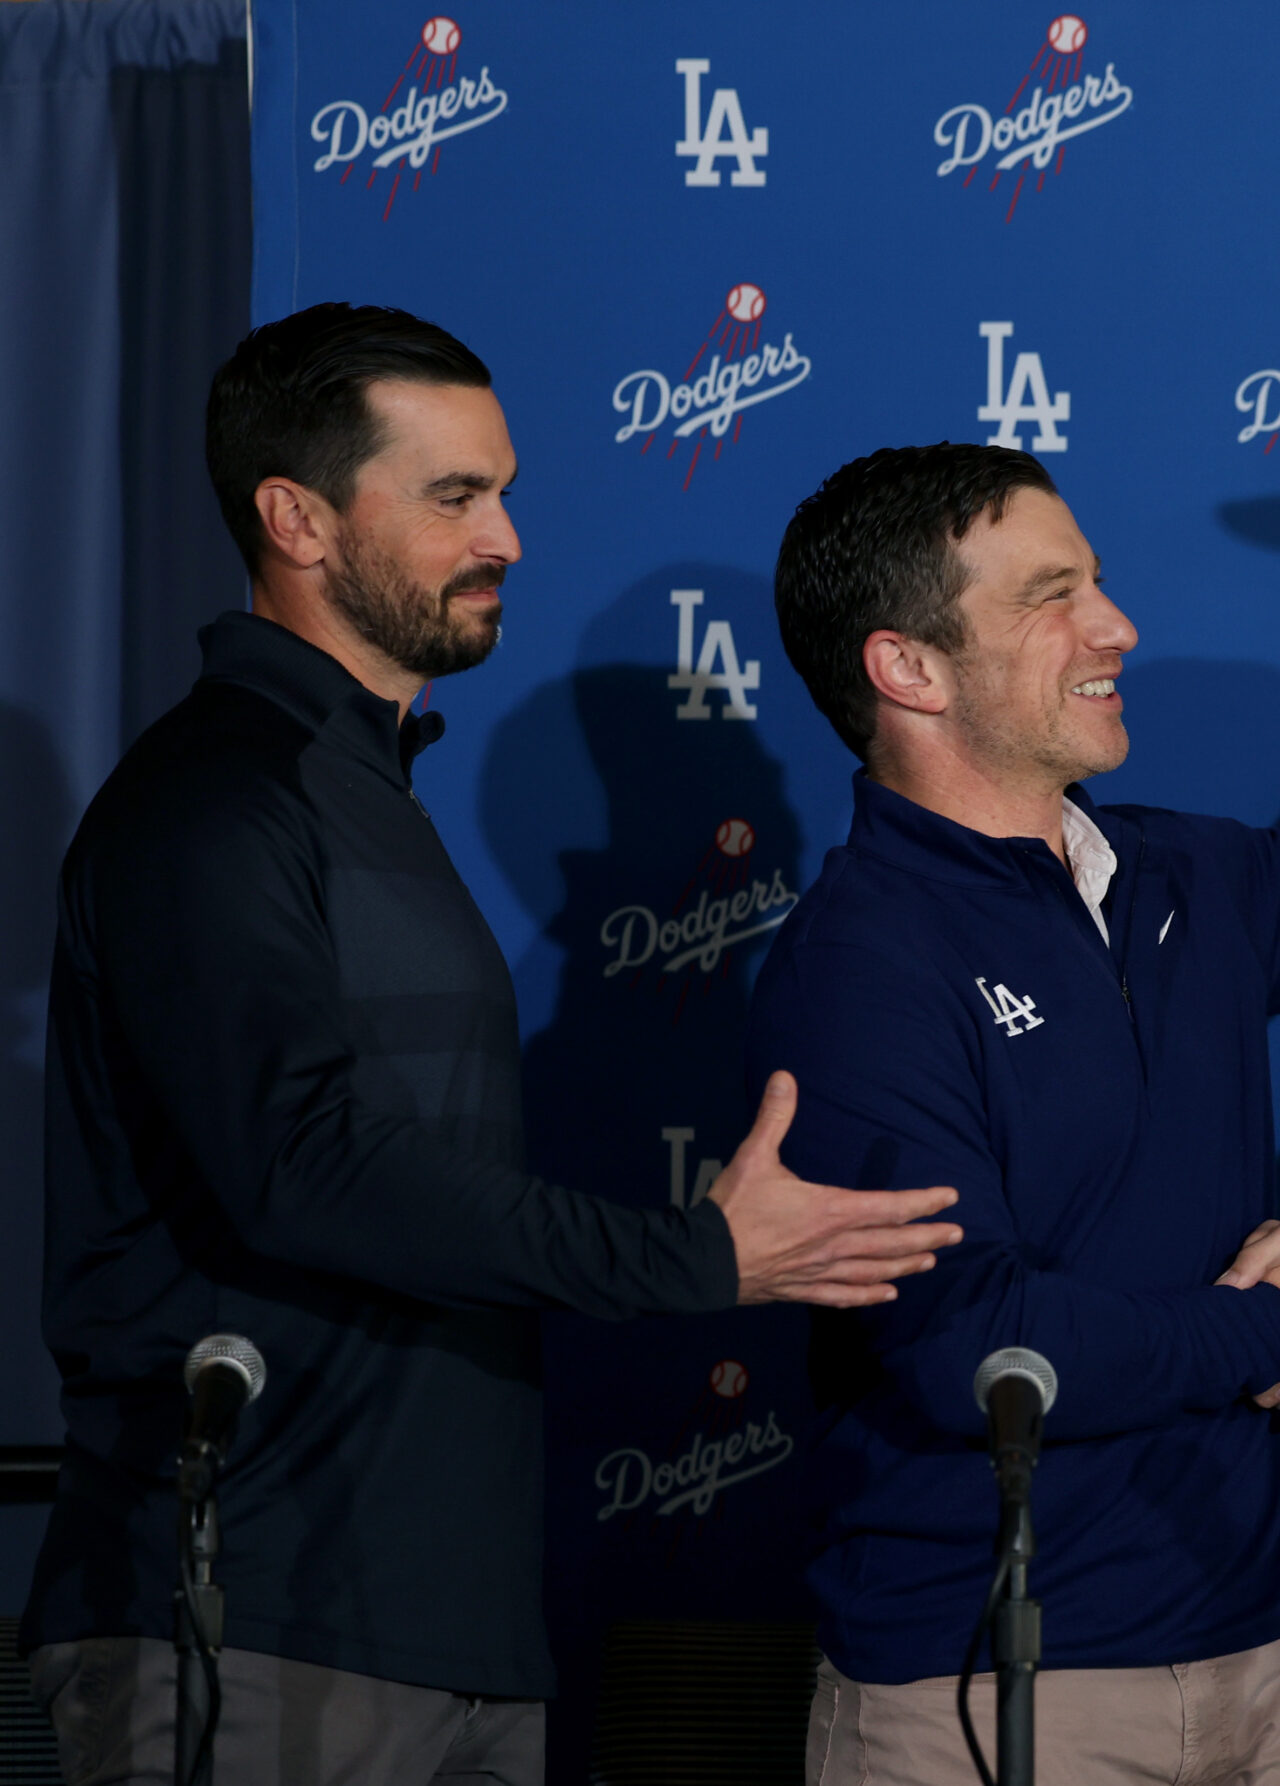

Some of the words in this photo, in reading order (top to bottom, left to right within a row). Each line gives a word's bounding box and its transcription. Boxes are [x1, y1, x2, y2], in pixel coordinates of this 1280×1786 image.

[311, 66, 509, 172] Dodgers
[675, 58, 769, 187] LA
[934, 62, 1133, 177] Dodgers
[613, 332, 812, 443] Dodgers
[977, 321, 1071, 452] LA
[668, 589, 761, 720] LA
[601, 868, 799, 978] Dodgers
[976, 976, 1045, 1038] LA
[595, 1410, 794, 1521] Dodgers
